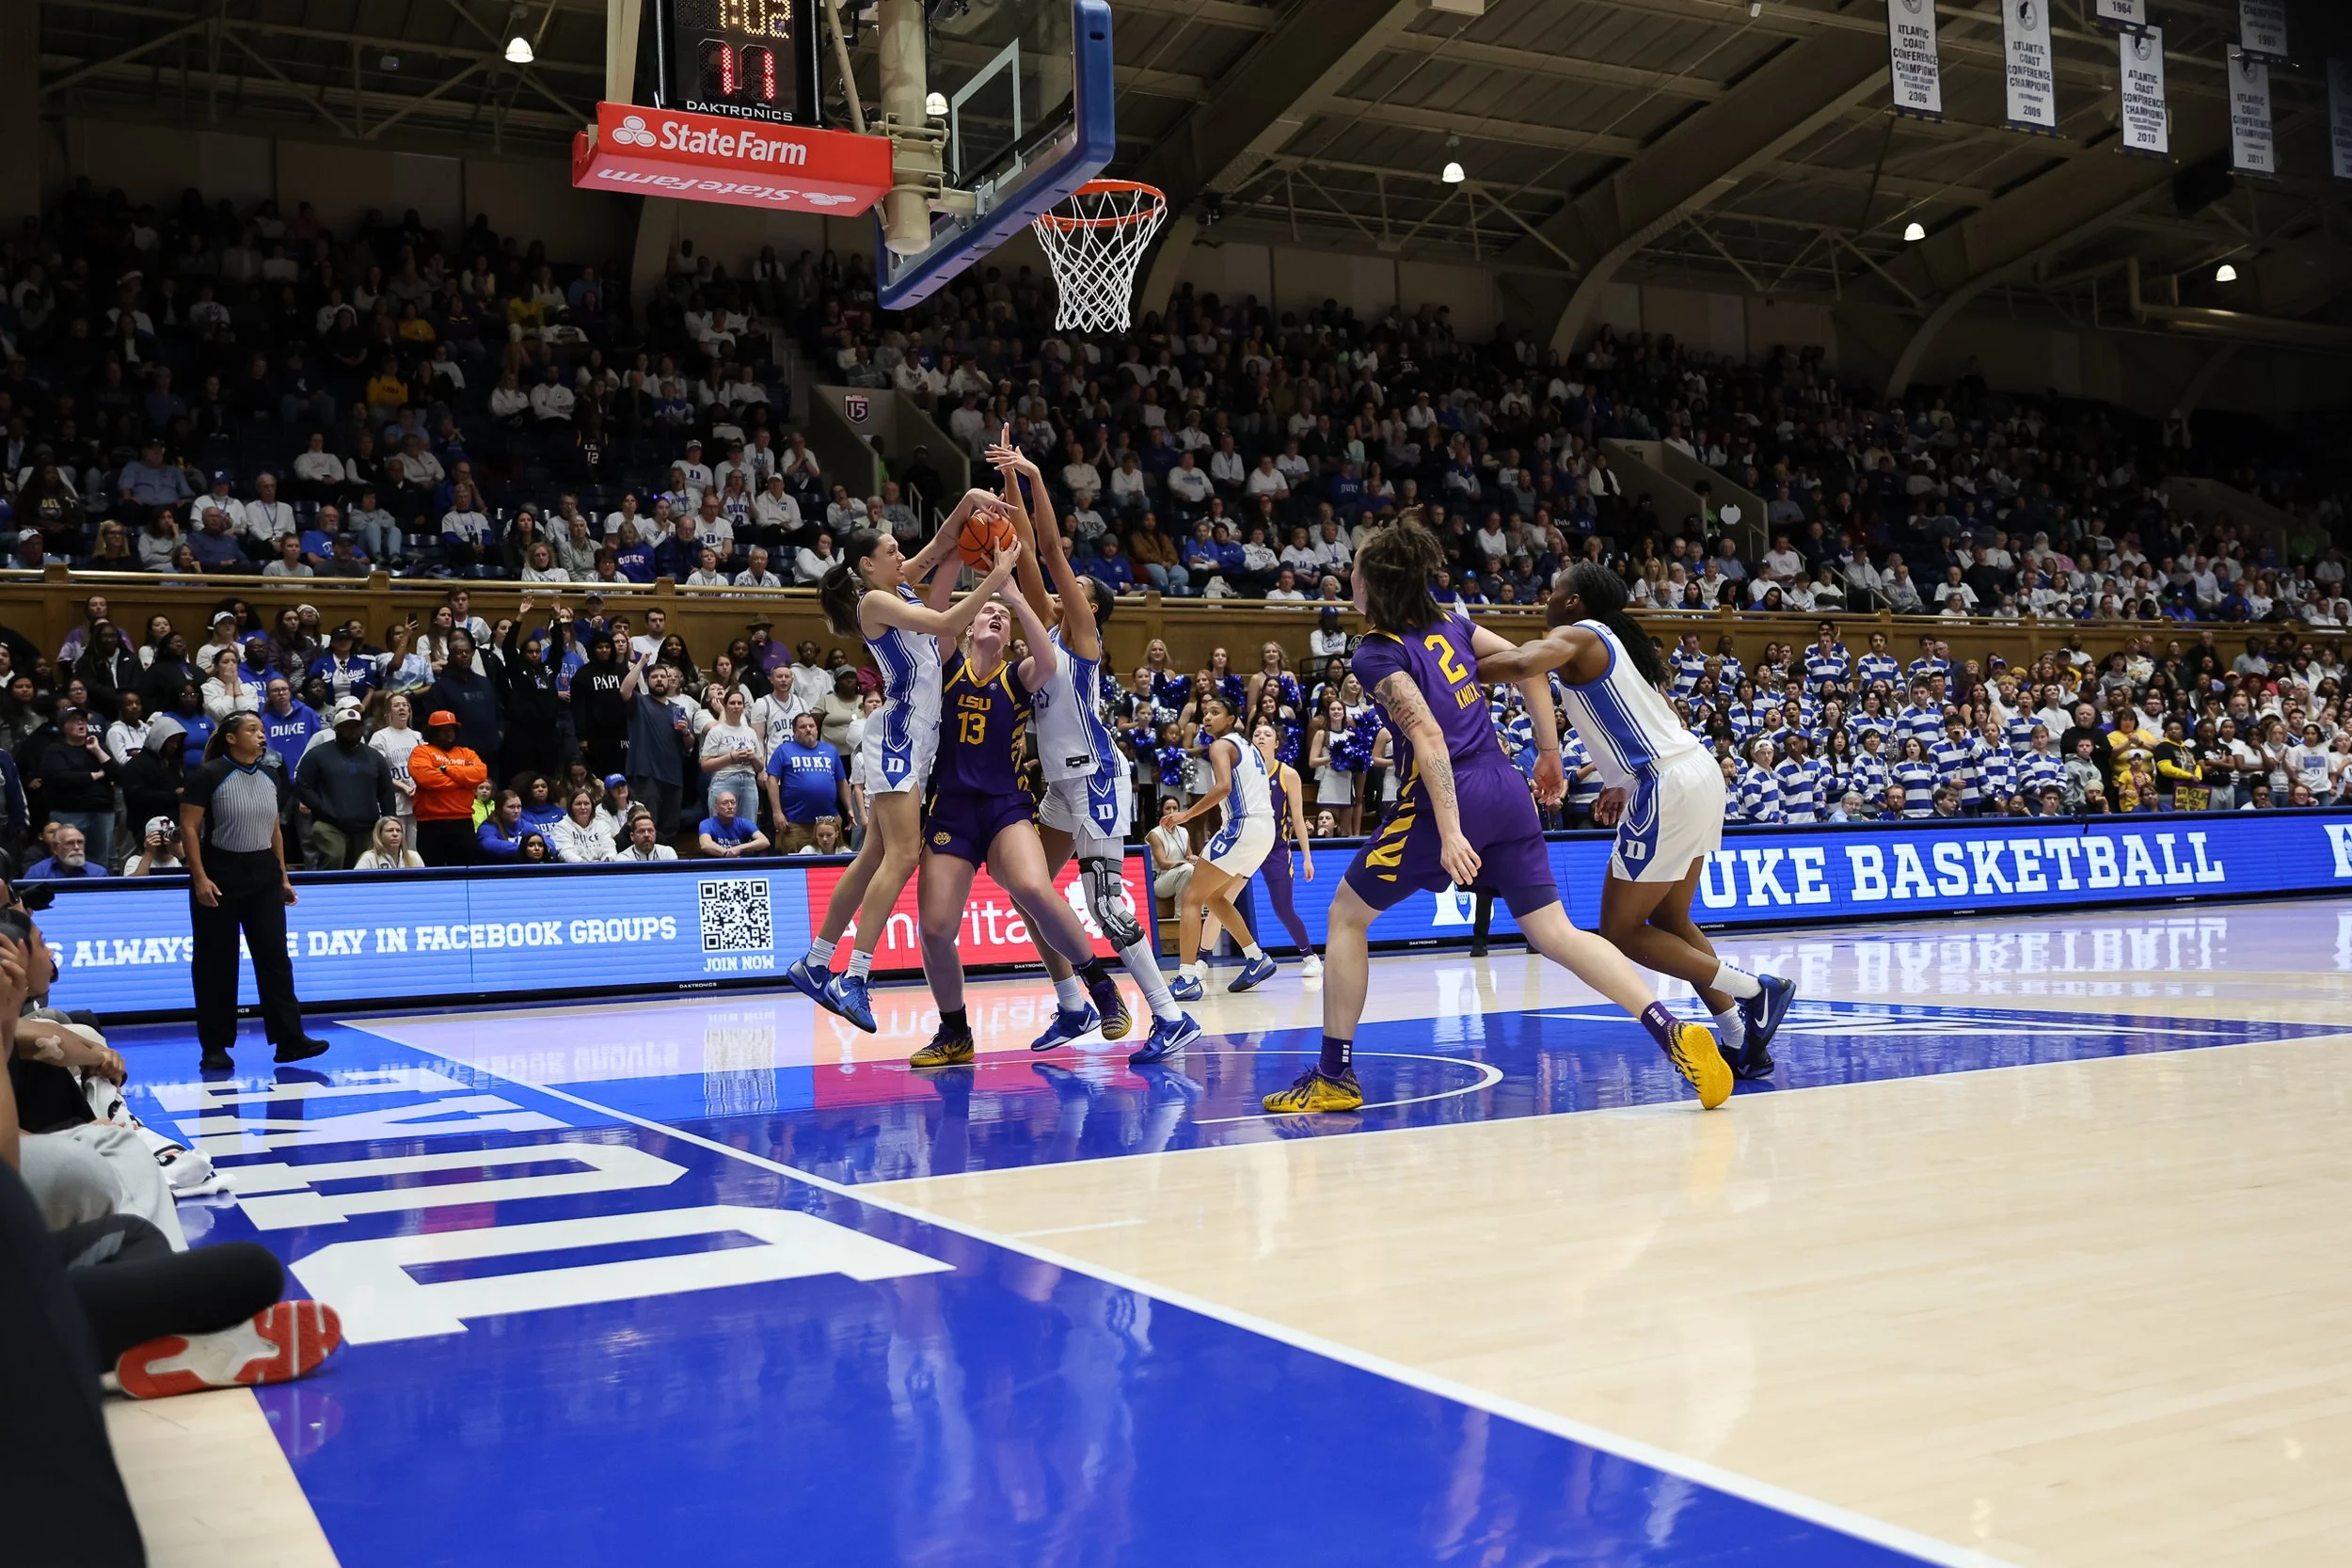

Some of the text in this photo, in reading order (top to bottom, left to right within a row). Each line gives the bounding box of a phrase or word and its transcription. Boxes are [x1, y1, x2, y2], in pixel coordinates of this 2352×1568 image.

[2112, 2, 2132, 14] 1964
[1898, 24, 1929, 40] ATLANTIC
[1903, 38, 1926, 50] COAST
[2012, 41, 2044, 55] ATLANTIC
[1893, 48, 1938, 65] CONFERENCE
[2019, 55, 2040, 67] COAST
[1896, 61, 1936, 77] CHAMPIONS
[2008, 65, 2051, 81] CONFERENCE
[2128, 70, 2158, 84] ATLANTIC
[2010, 77, 2050, 93] CHAMPIONS
[2135, 82, 2154, 95] COAST
[1909, 91, 1927, 103] 2006
[2122, 92, 2165, 109] CONFERENCE
[2237, 93, 2265, 106] ATLANTIC
[686, 100, 793, 122] DAKTRONICS
[2023, 105, 2042, 118] 2009
[2125, 104, 2164, 120] CHAMPIONS
[2242, 105, 2262, 117] COAST
[2233, 115, 2271, 129] CONFERENCE
[2137, 133, 2156, 144] 2010
[2235, 127, 2272, 141] CHAMPIONS
[2248, 153, 2265, 165] 2011
[850, 403, 866, 419] 15
[617, 554, 645, 564] DUKE
[1327, 639, 1345, 652] Duke
[1424, 634, 1469, 685] 2
[958, 693, 993, 712] LSU
[1454, 683, 1483, 710] KNOX
[271, 722, 306, 738] DUKE
[773, 719, 795, 733] DUK
[958, 712, 987, 745] 13
[791, 756, 832, 769] DUKE
[886, 757, 905, 774] D
[1253, 749, 1267, 775] 4
[1096, 804, 1115, 820] D
[1214, 840, 1229, 853] D
[1624, 839, 1646, 860] D
[1702, 832, 2226, 910] UKE BASKETBALL
[308, 929, 368, 958] DAY
[375, 927, 408, 954] IN
[415, 918, 564, 951] FACEBOOK
[569, 916, 677, 944] GROUPS
[702, 954, 775, 973] JOIN NOW
[1015, 961, 1046, 970] DAKTRONIC
[678, 981, 718, 990] DAKTRONICS
